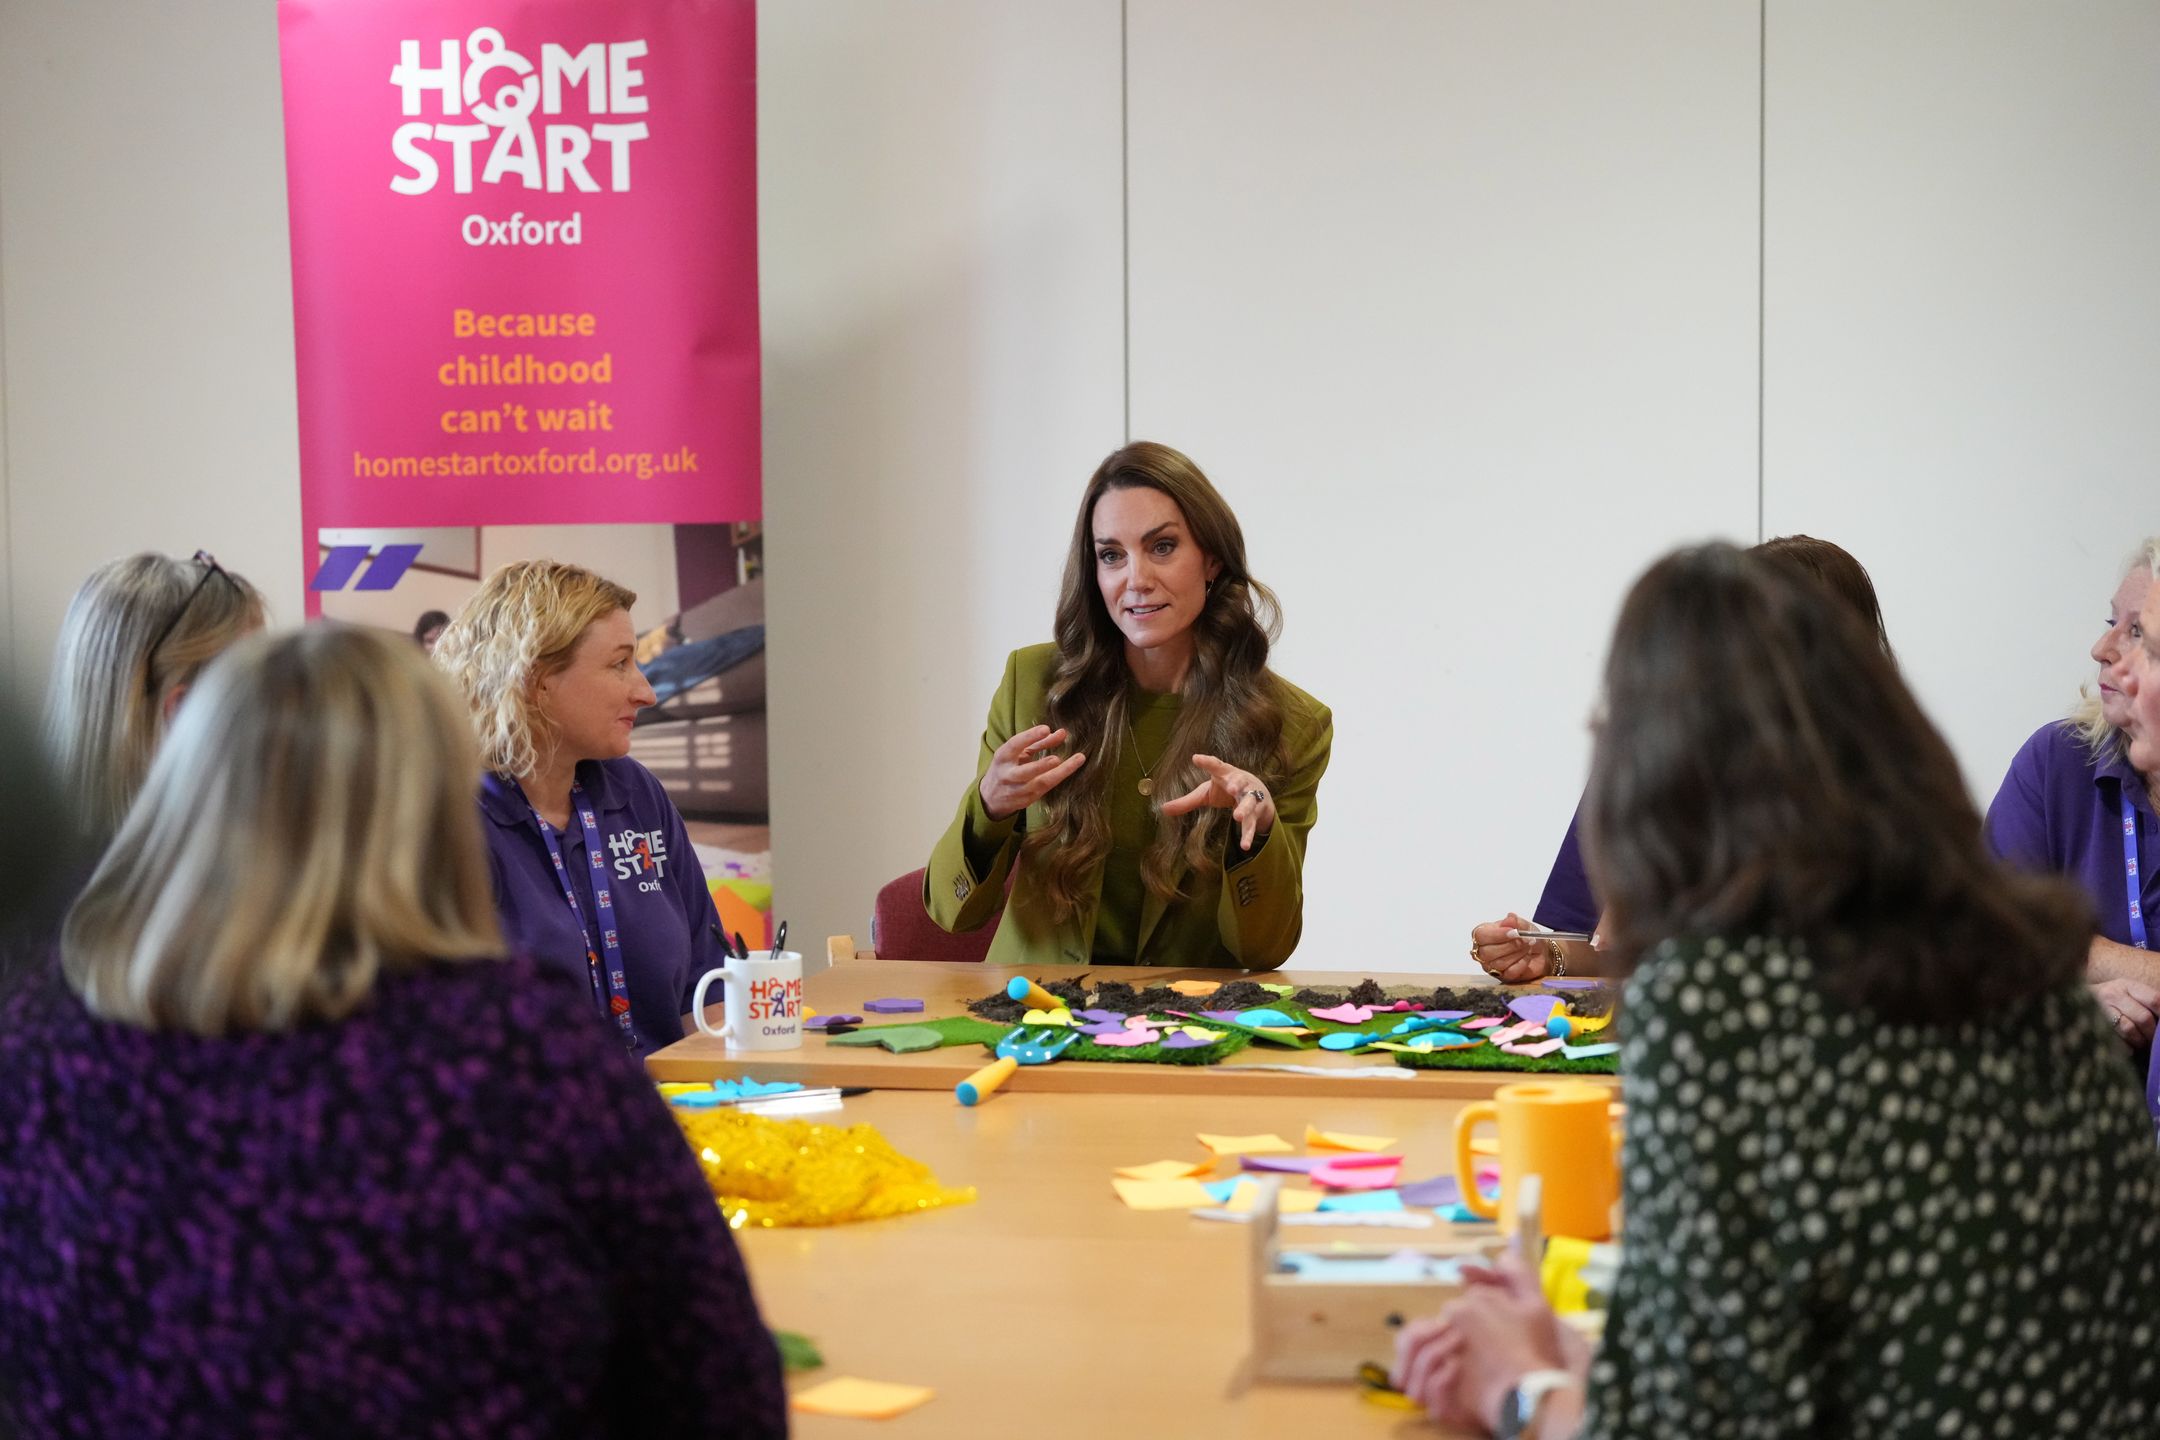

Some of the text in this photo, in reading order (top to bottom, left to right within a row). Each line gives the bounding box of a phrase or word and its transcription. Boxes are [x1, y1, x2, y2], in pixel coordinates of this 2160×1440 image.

[389, 27, 649, 127] HOME
[389, 121, 649, 195] START
[461, 212, 582, 246] Oxford
[454, 309, 596, 338] Because
[438, 353, 612, 386] childhood
[441, 400, 613, 433] can’t wait
[354, 447, 698, 480] homestartoxford.org.uk
[762, 1024, 796, 1036] Oxford
